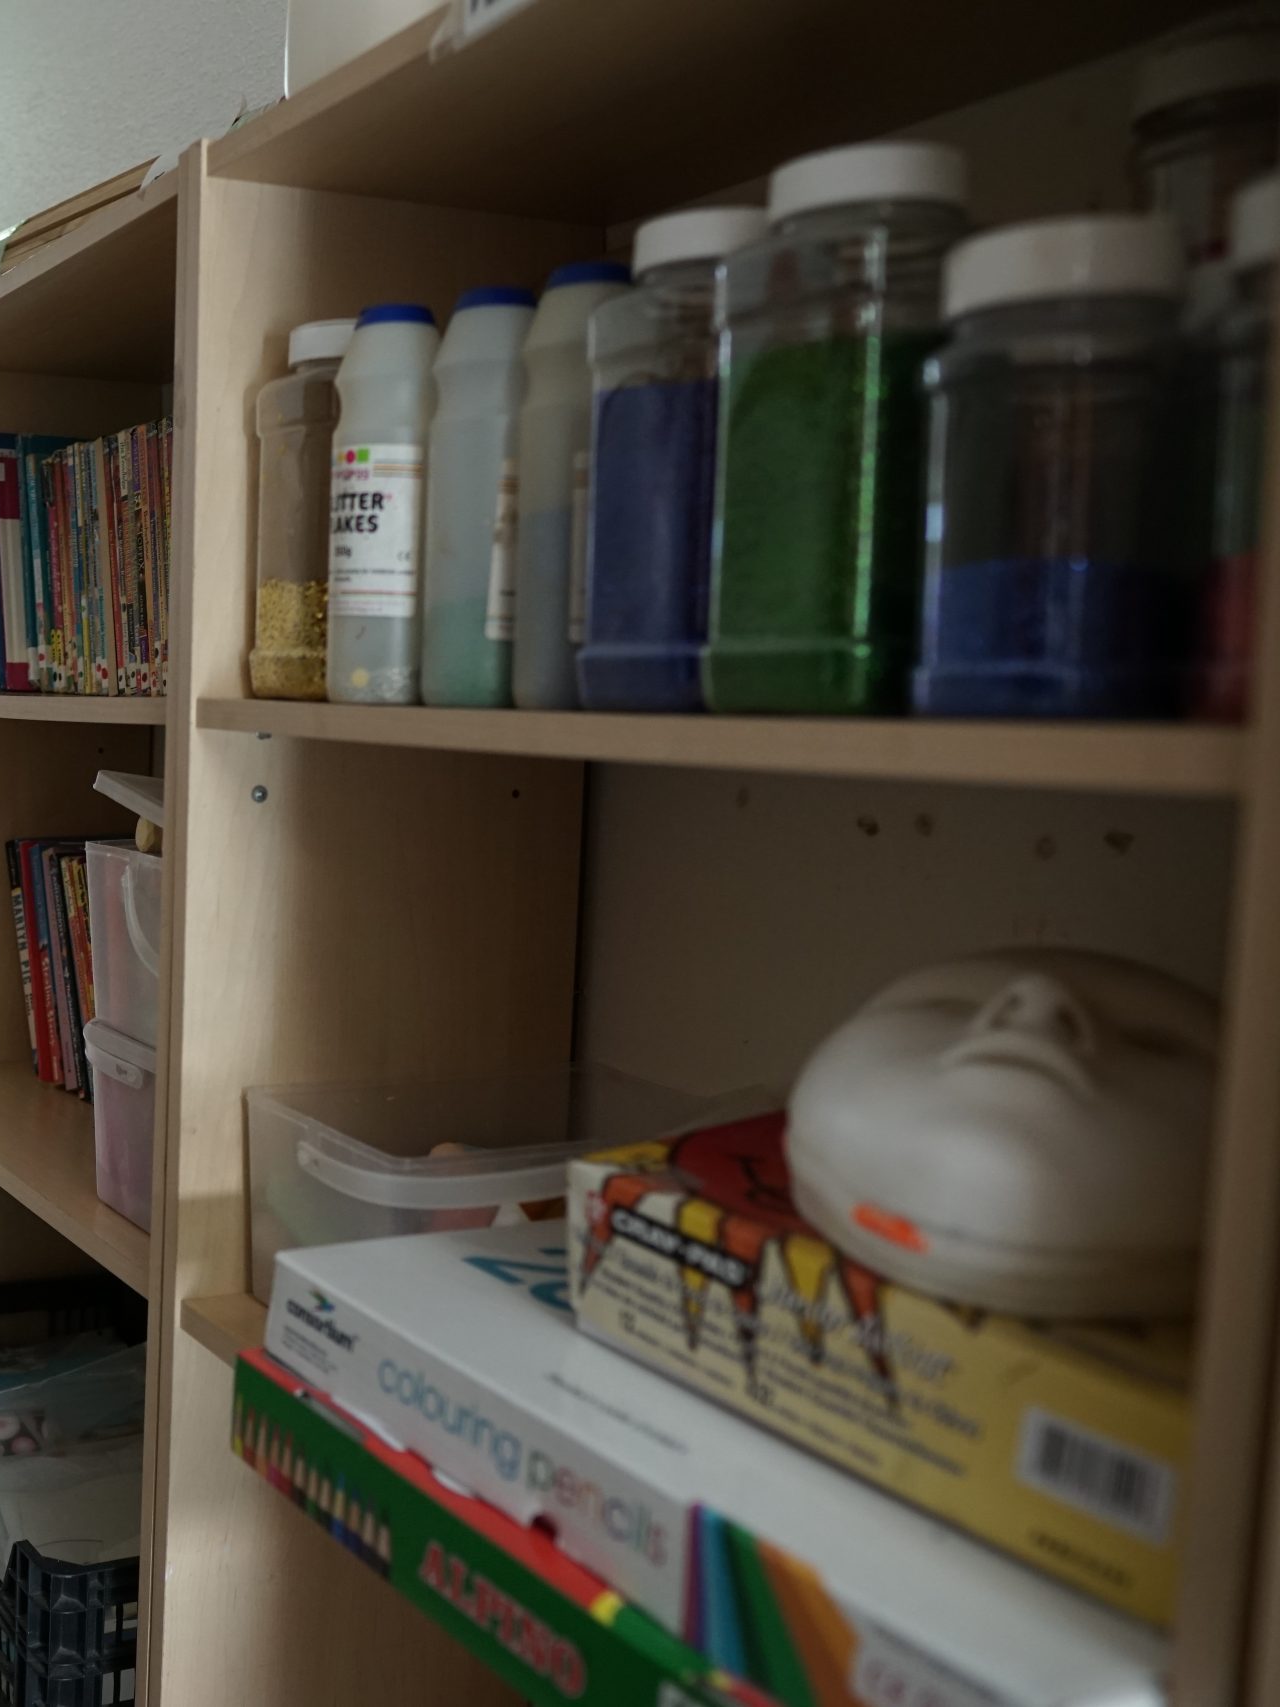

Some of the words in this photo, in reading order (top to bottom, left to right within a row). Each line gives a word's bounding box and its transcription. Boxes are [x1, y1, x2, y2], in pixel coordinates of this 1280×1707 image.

[11, 894, 28, 951] MARTYN
[21, 958, 32, 985] PIG
[377, 1354, 522, 1479] colouring
[526, 1450, 667, 1567] pencils
[418, 1541, 587, 1697] ALPINO
